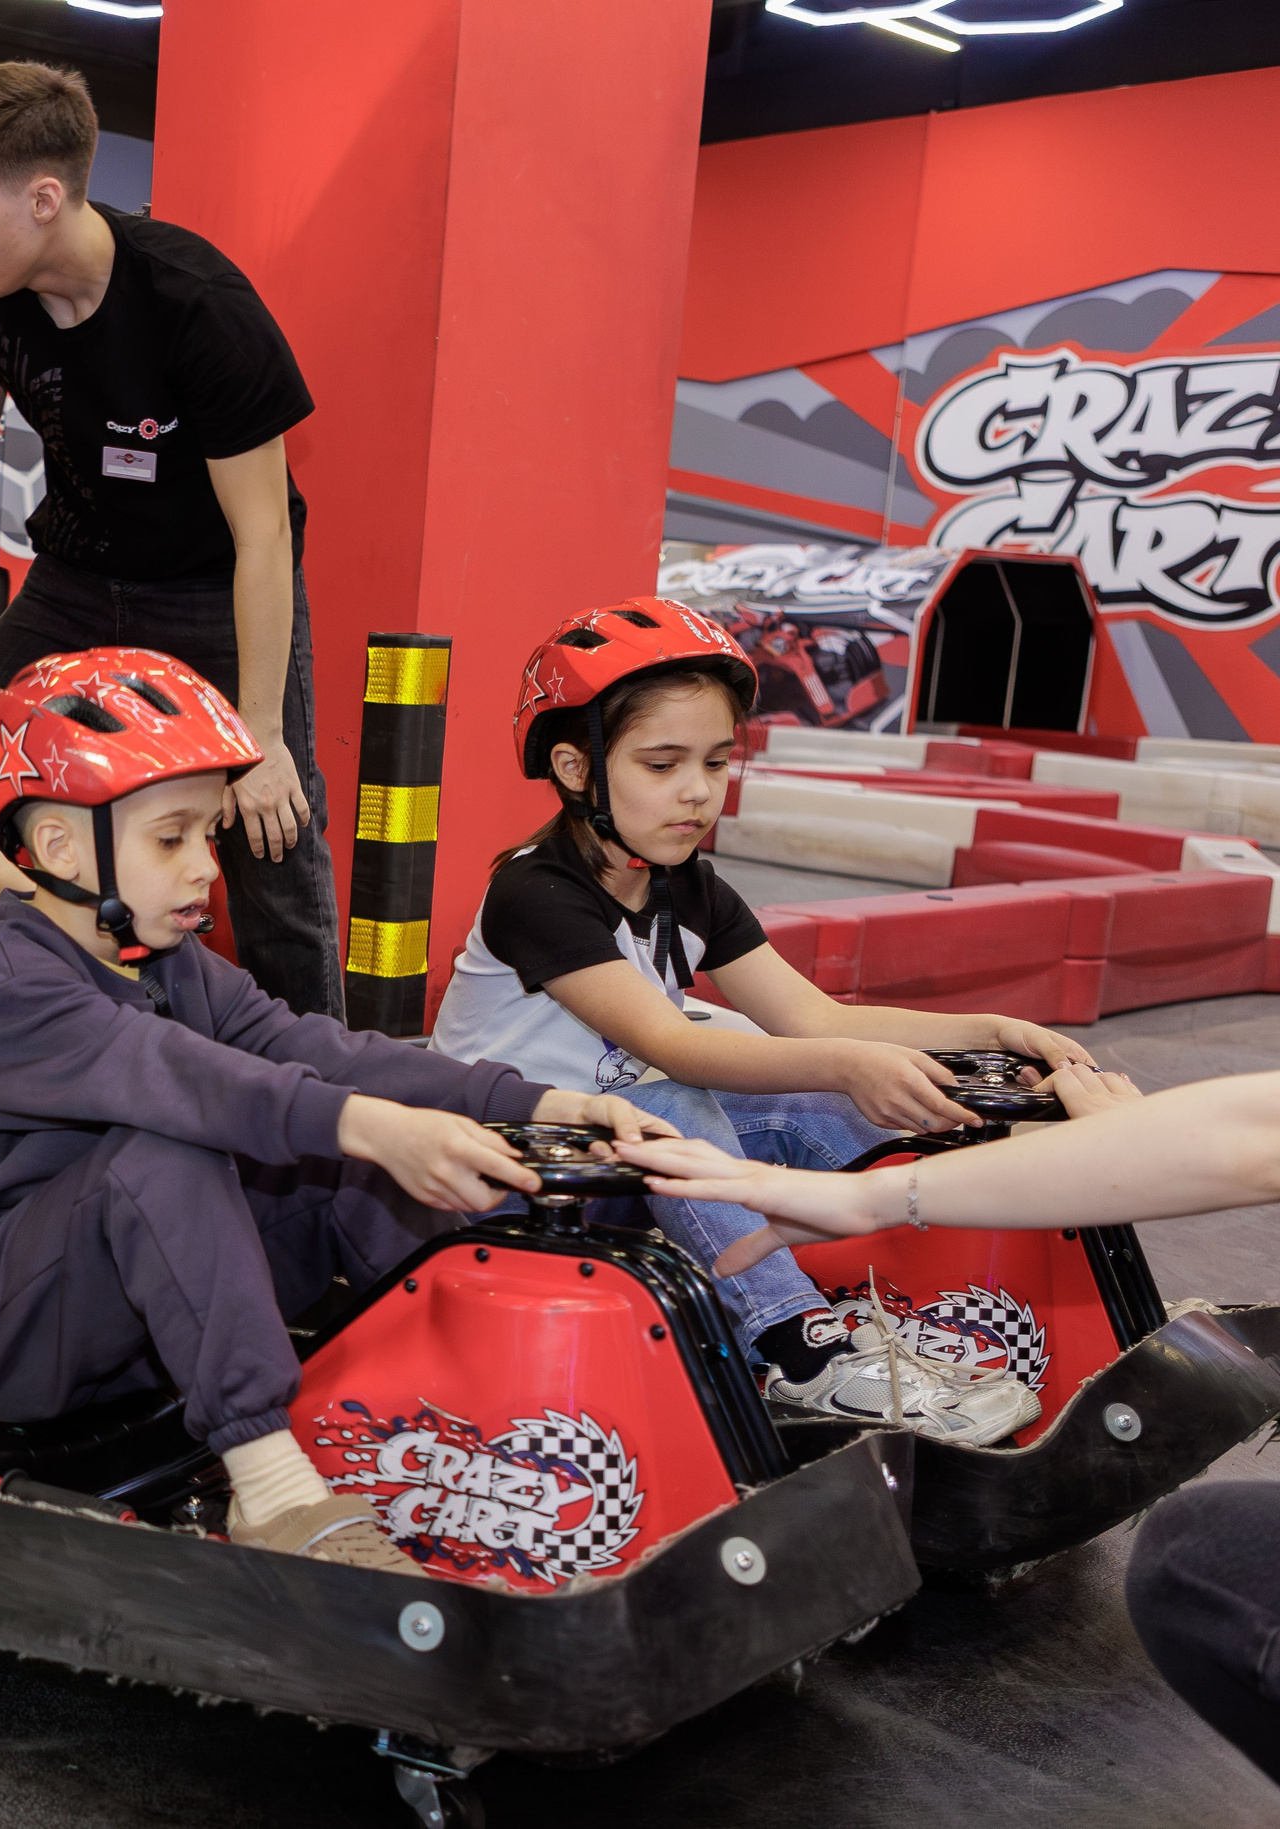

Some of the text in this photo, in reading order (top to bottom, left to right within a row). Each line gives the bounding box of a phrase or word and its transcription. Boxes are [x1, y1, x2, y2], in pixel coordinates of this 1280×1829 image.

[918, 350, 1280, 490] CRAZ
[657, 559, 804, 598] CRAZY
[376, 1429, 594, 1516] CRAZY
[386, 1486, 559, 1551] CART
